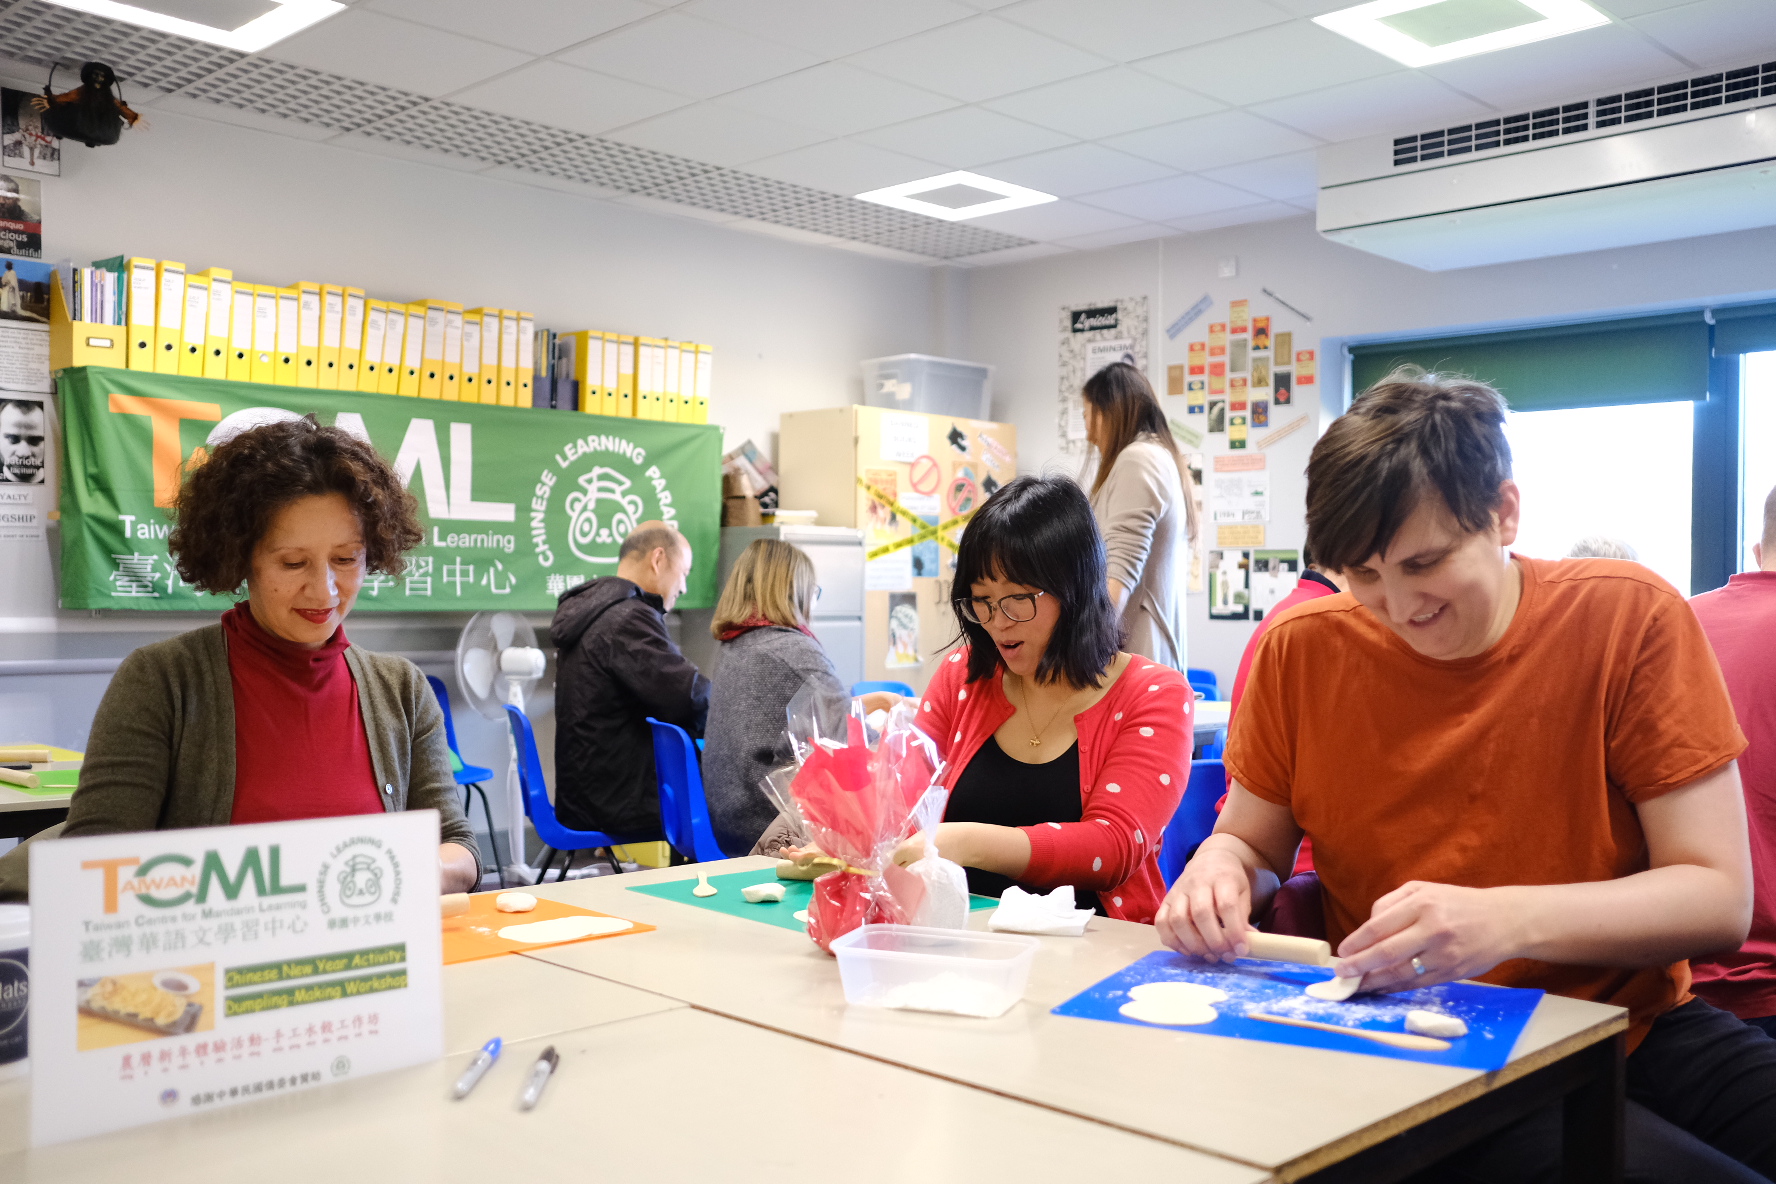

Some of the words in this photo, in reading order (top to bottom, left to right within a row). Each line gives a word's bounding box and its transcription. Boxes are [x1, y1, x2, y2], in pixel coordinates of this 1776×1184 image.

[555, 434, 646, 468] LEARNING
[530, 468, 557, 567] CHINESE
[433, 526, 515, 553] Learning
[329, 836, 382, 859] LEARNING
[81, 843, 307, 915] TCML
[316, 861, 331, 915] CHINESE
[83, 920, 131, 933] Taiwan
[135, 914, 178, 927] Centre
[181, 912, 197, 922] for
[202, 905, 255, 918] Mandarin
[258, 899, 307, 913] Learning
[225, 969, 279, 987] Chinese
[282, 963, 313, 978] New
[316, 958, 348, 972] Year
[344, 975, 408, 995] Workshop
